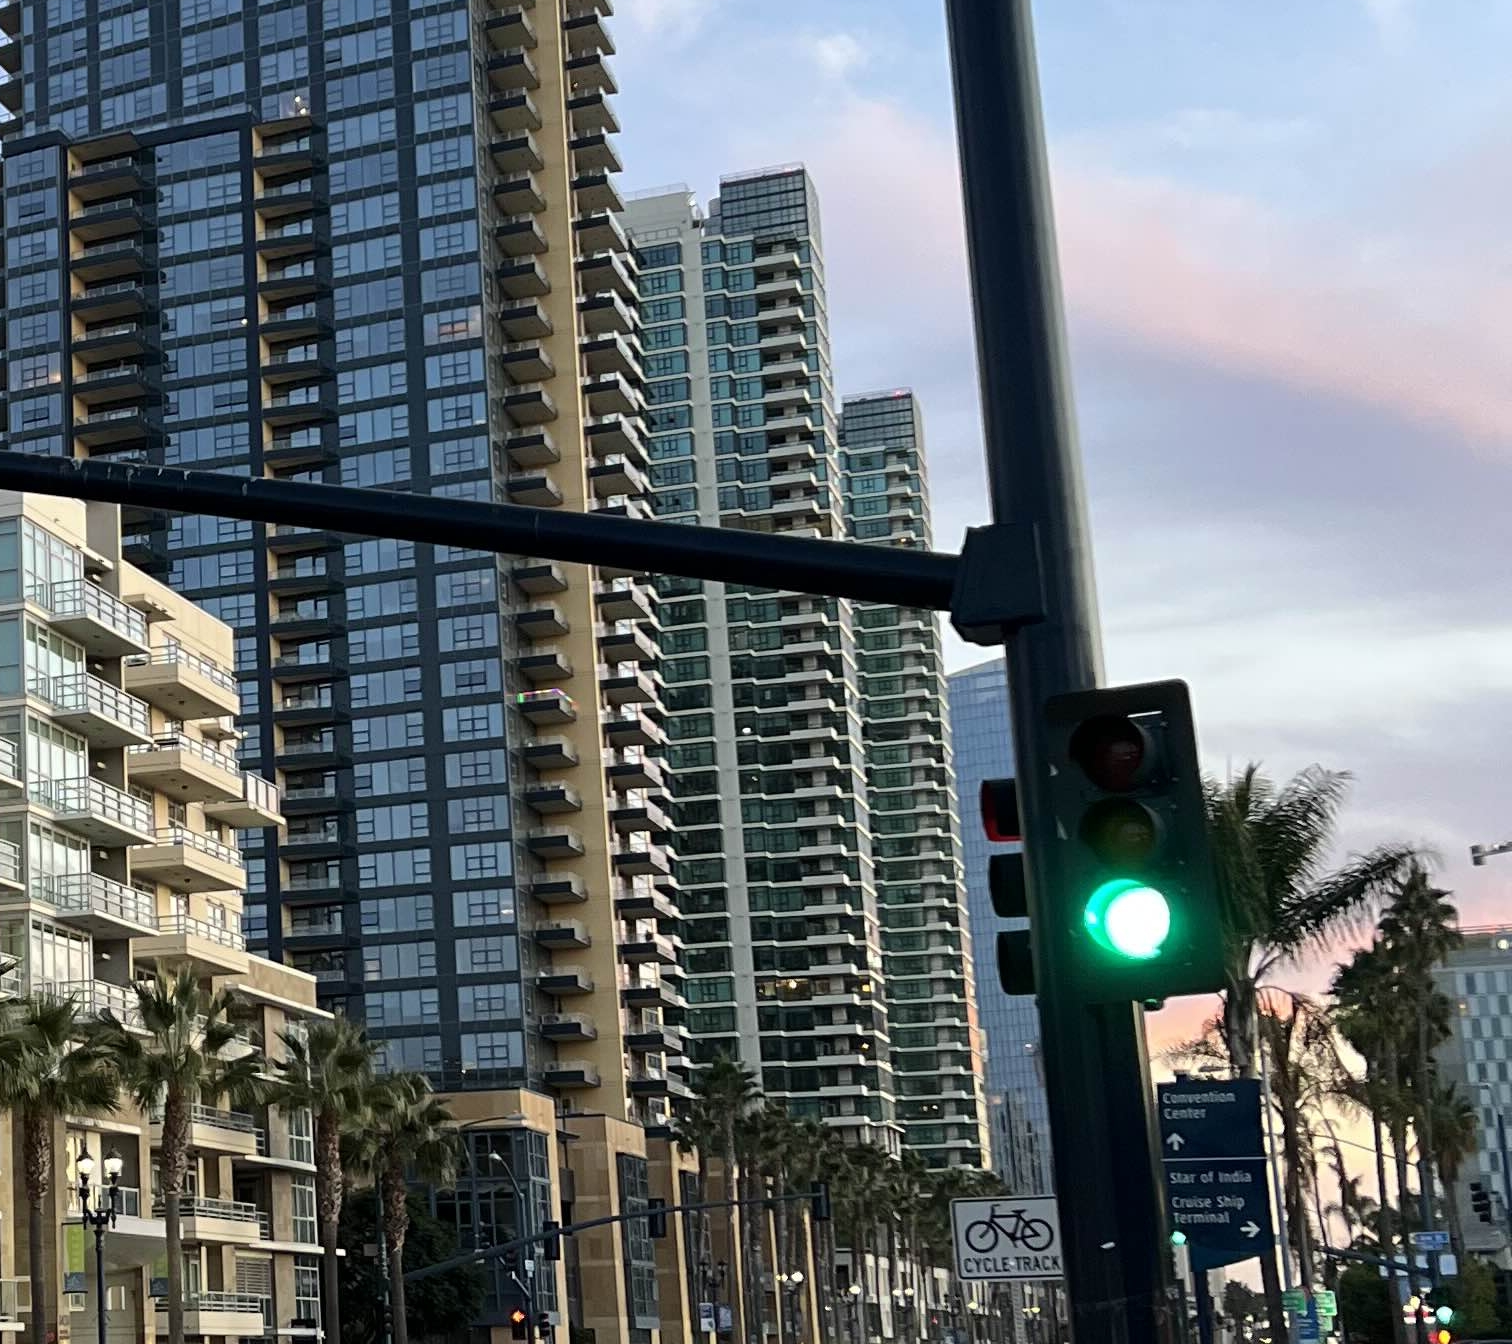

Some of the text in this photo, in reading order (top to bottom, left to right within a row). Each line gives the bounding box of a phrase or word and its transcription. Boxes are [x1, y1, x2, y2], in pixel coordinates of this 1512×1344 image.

[1162, 1090, 1236, 1104] Convention
[1163, 1107, 1206, 1120] Center
[1169, 1169, 1253, 1184] Star of India
[1171, 1194, 1246, 1211] Cruise Ship
[1173, 1210, 1231, 1224] Terminal
[963, 1255, 1062, 1274] CYCLE TRACK
